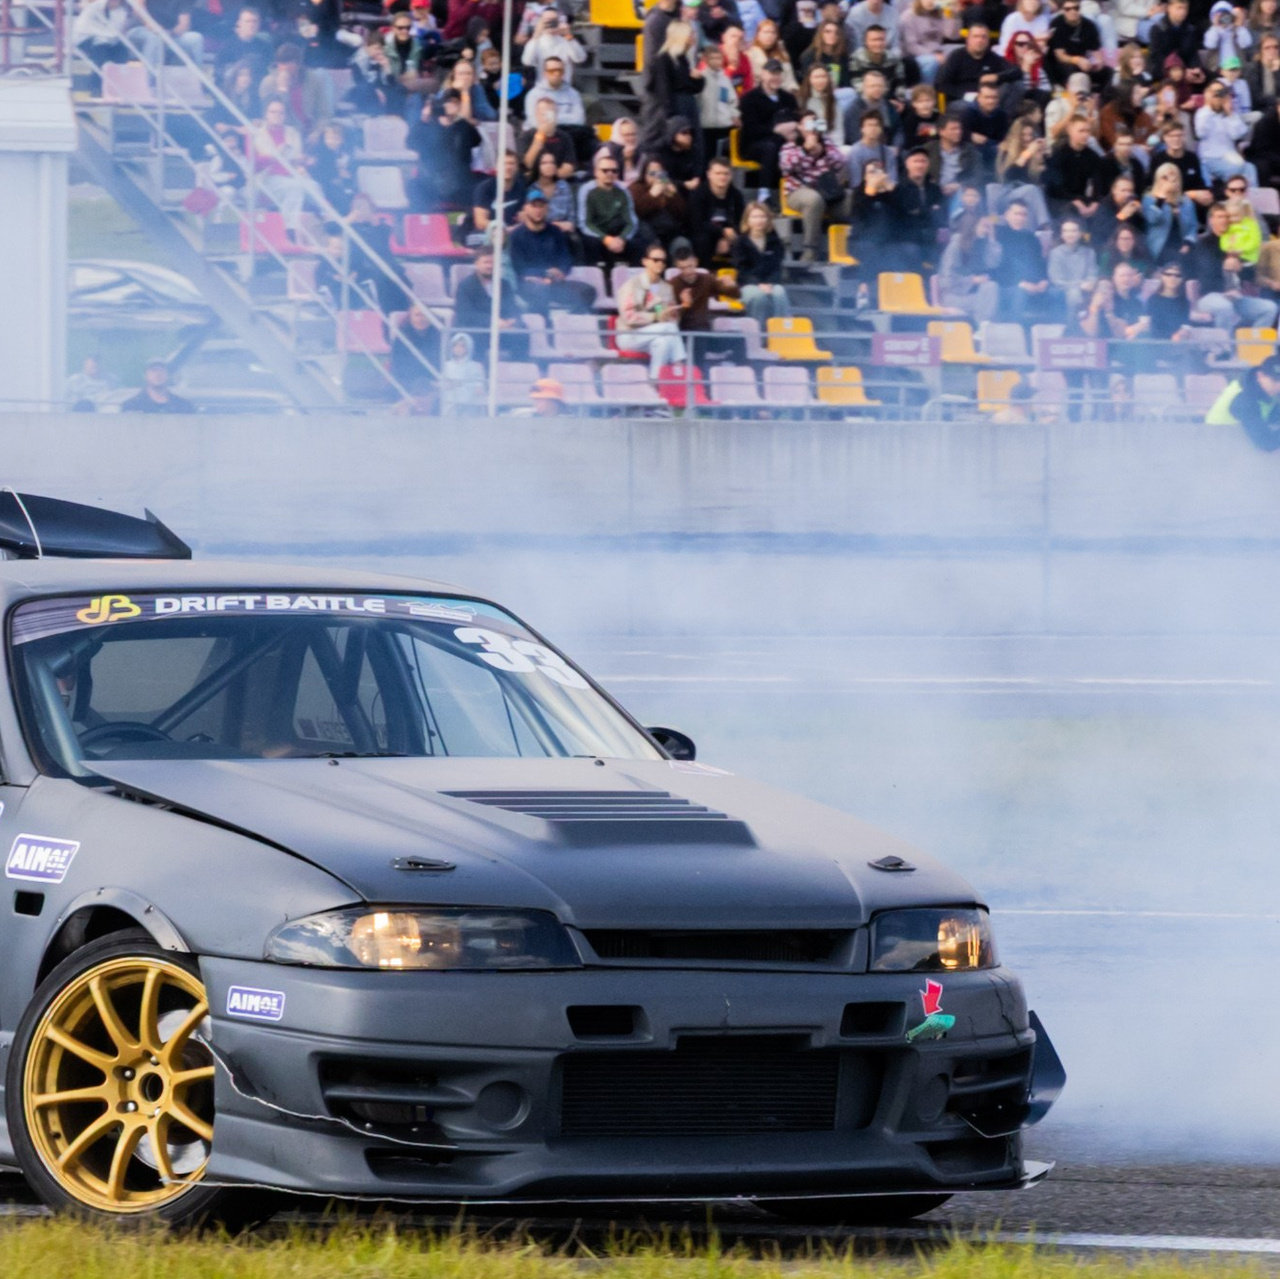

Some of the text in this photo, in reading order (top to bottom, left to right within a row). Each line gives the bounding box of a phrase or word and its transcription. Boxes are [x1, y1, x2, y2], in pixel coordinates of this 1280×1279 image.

[155, 594, 386, 614] DRIFT BATTLE
[453, 626, 592, 690] 33
[229, 992, 282, 1015] AIMOL
